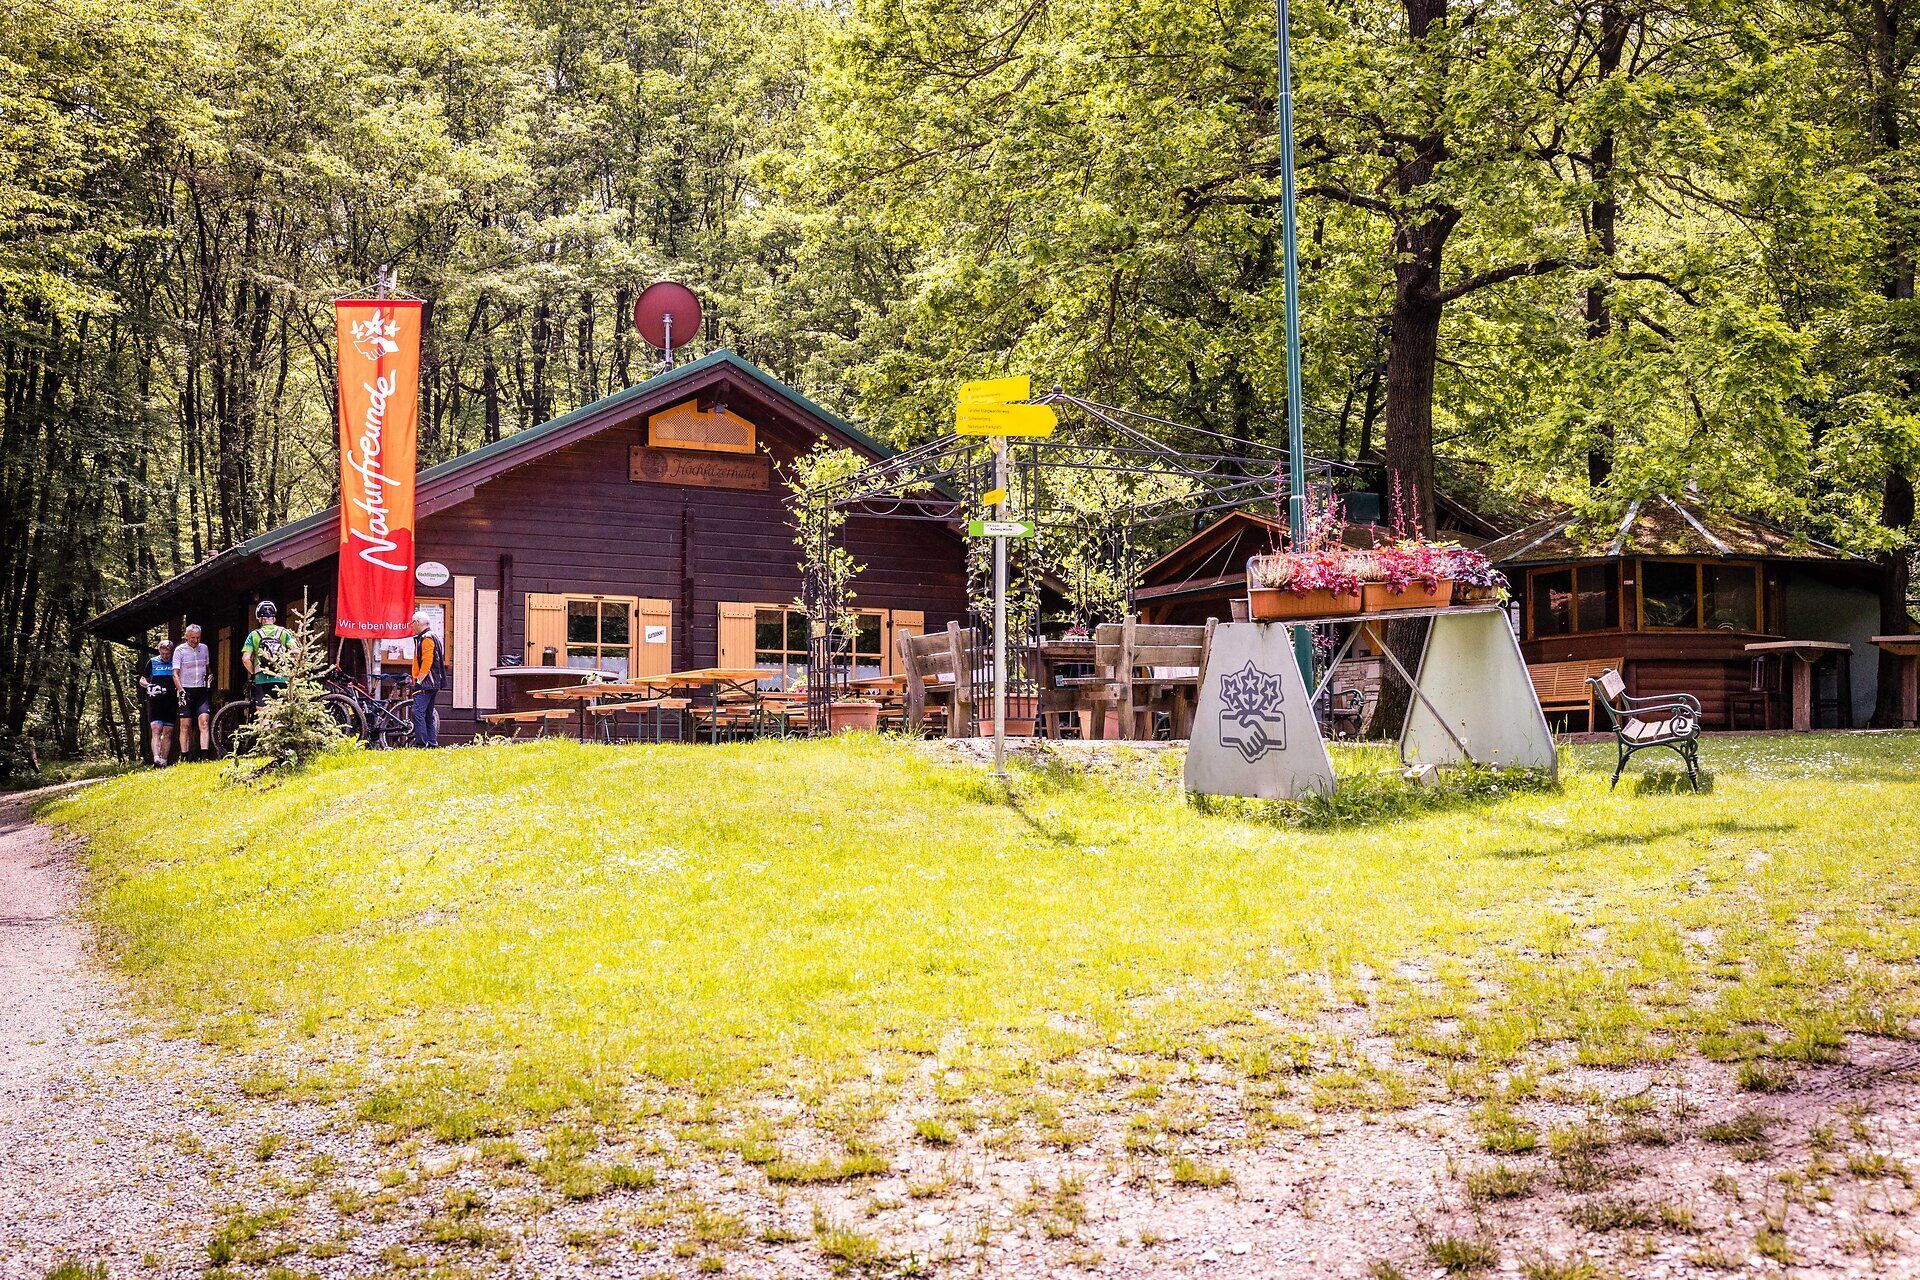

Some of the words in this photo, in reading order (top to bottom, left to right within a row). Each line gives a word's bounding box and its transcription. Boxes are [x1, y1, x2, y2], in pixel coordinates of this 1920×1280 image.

[347, 369, 408, 571] Naturfreunde
[339, 619, 355, 629] Wir
[358, 621, 384, 630] leben
[385, 621, 410, 630] Natur
